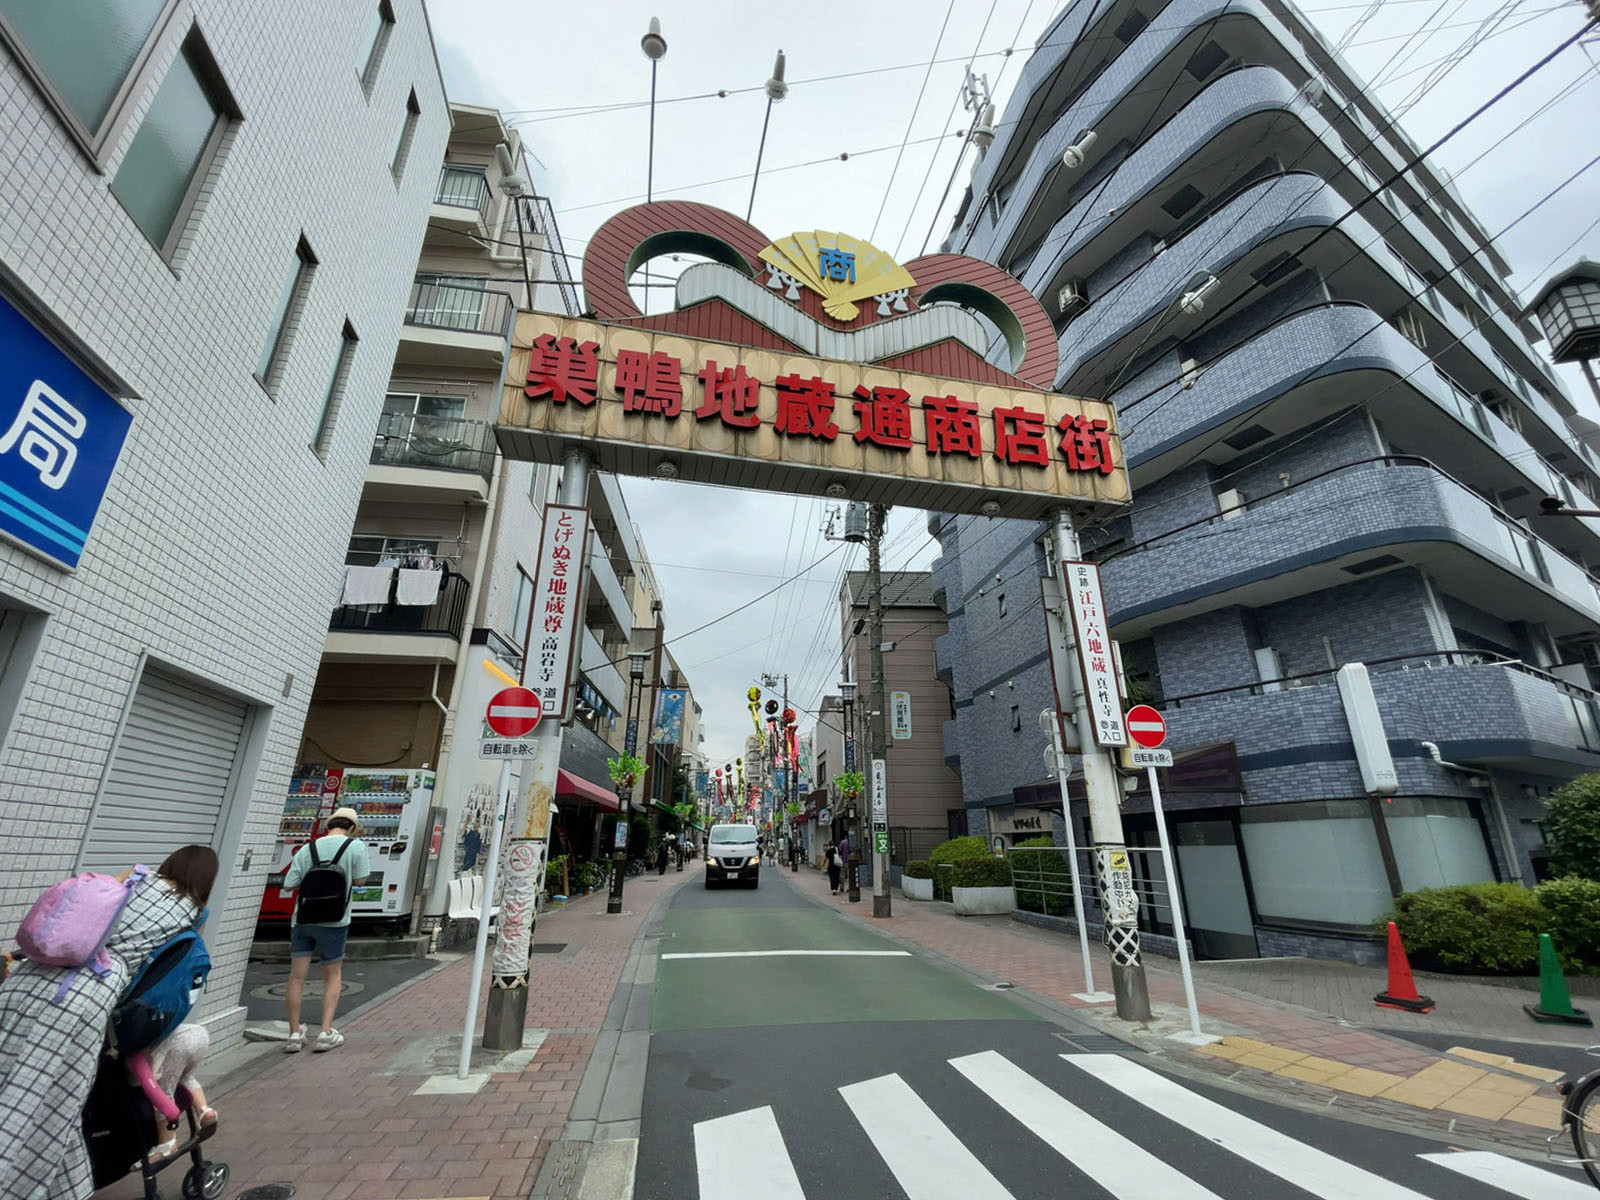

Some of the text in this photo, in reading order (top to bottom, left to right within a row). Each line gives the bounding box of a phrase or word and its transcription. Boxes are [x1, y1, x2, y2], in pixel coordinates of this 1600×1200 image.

[819, 247, 856, 284] 商
[0, 379, 87, 490] 局
[523, 332, 1114, 475] 巣鴨地蔵通商店街
[540, 511, 575, 682] とげぬき地蔵尊 高岩寺
[1079, 589, 1107, 674] 江戸六地蔵
[1096, 677, 1112, 717] 真性寺
[482, 743, 535, 756] 自転車を除く
[1103, 731, 1121, 741] 入口
[1133, 752, 1172, 763] 自転車を除く
